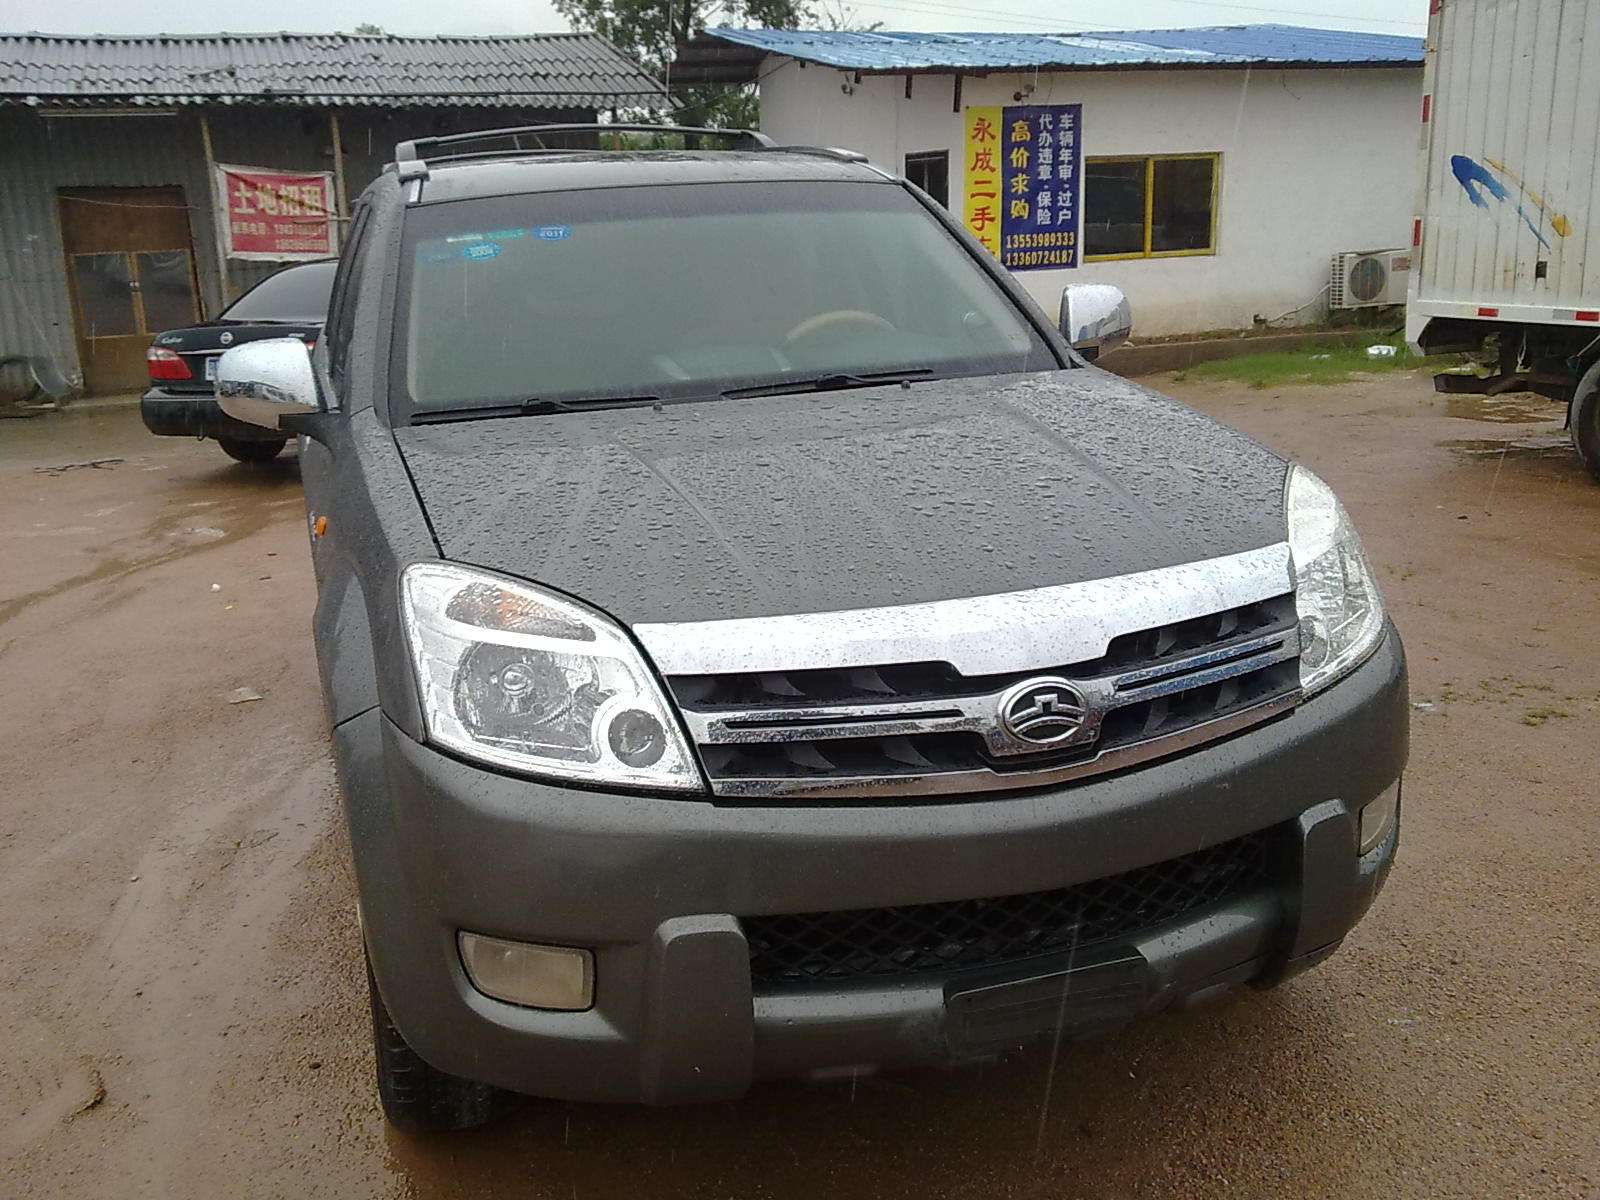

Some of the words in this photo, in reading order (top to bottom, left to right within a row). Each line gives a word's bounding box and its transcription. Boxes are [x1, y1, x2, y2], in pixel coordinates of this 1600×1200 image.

[1010, 119, 1032, 220] 高价求购
[1006, 232, 1075, 249] 13553989333
[1006, 250, 1074, 267] 13360724187
